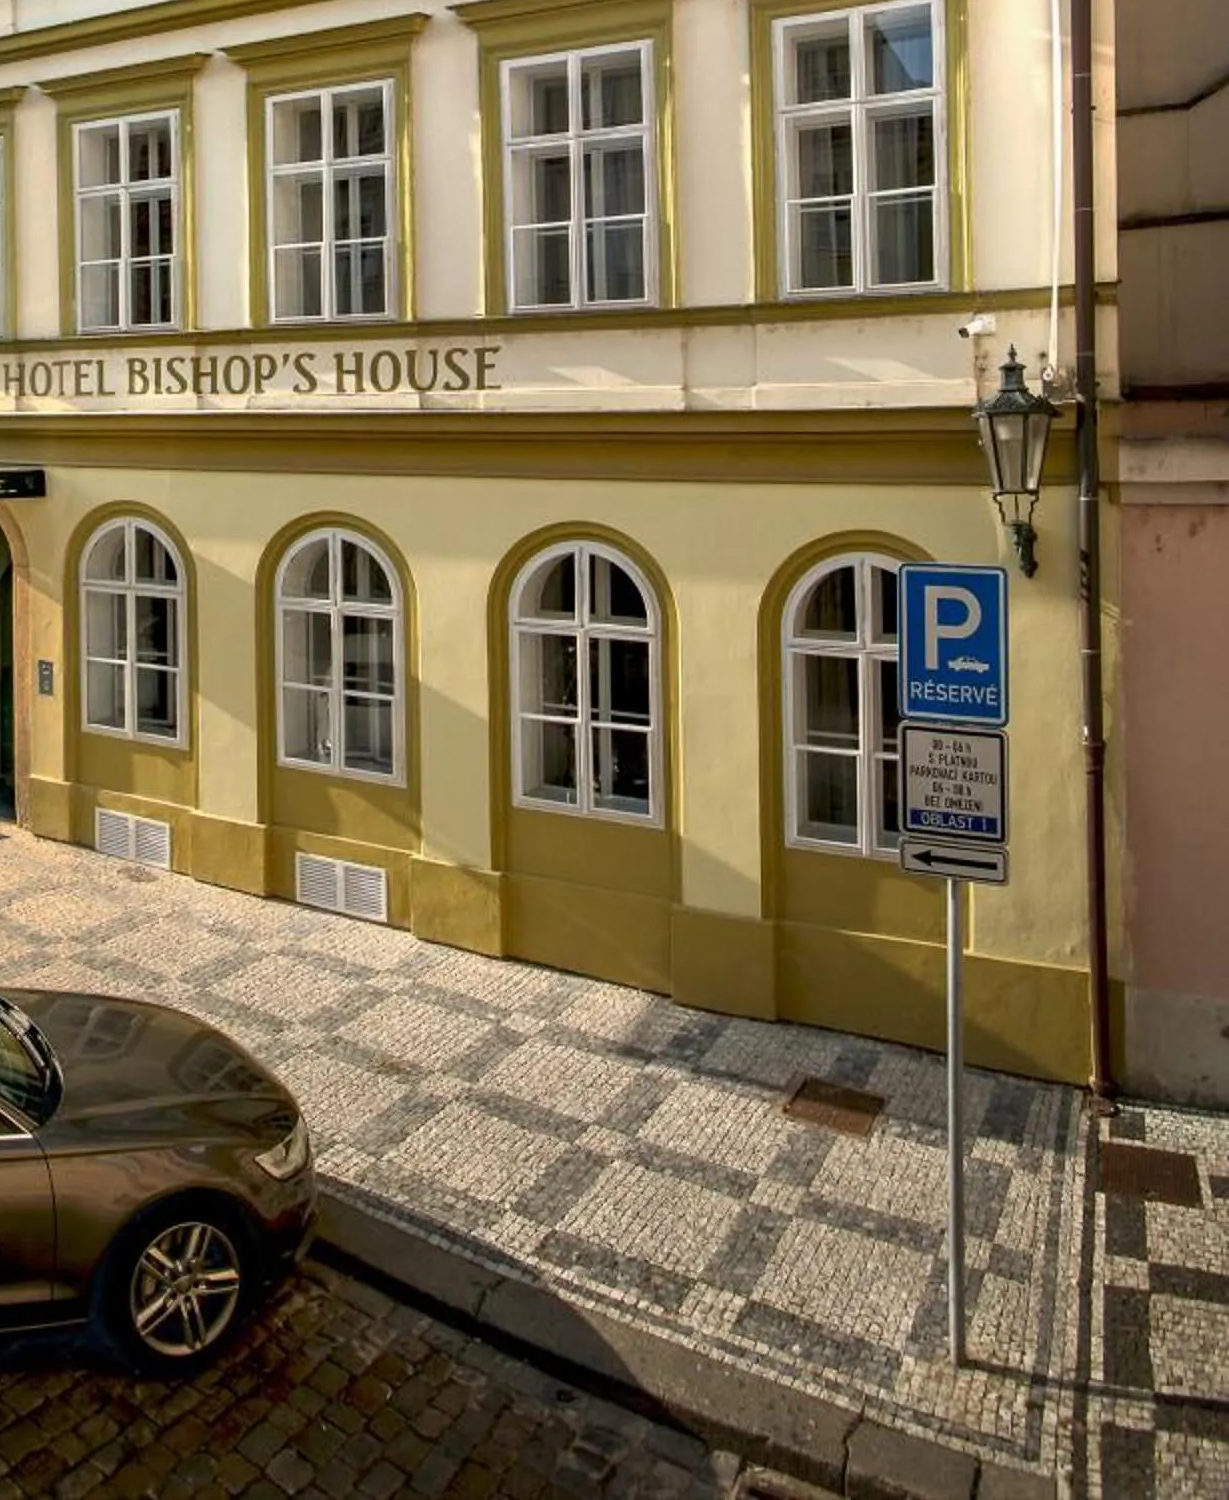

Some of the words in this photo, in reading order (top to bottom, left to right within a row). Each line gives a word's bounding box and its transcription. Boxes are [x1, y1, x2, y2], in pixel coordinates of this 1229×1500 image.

[3, 359, 116, 397] HOTEL
[127, 352, 318, 396] BISHOP'S
[333, 346, 502, 394] HOUSE
[925, 585, 981, 670] P
[911, 679, 998, 706] RÉSERVÉ
[938, 753, 978, 769] PLATNOU
[962, 770, 996, 785] KARTOU
[921, 812, 973, 829] OBLAST
